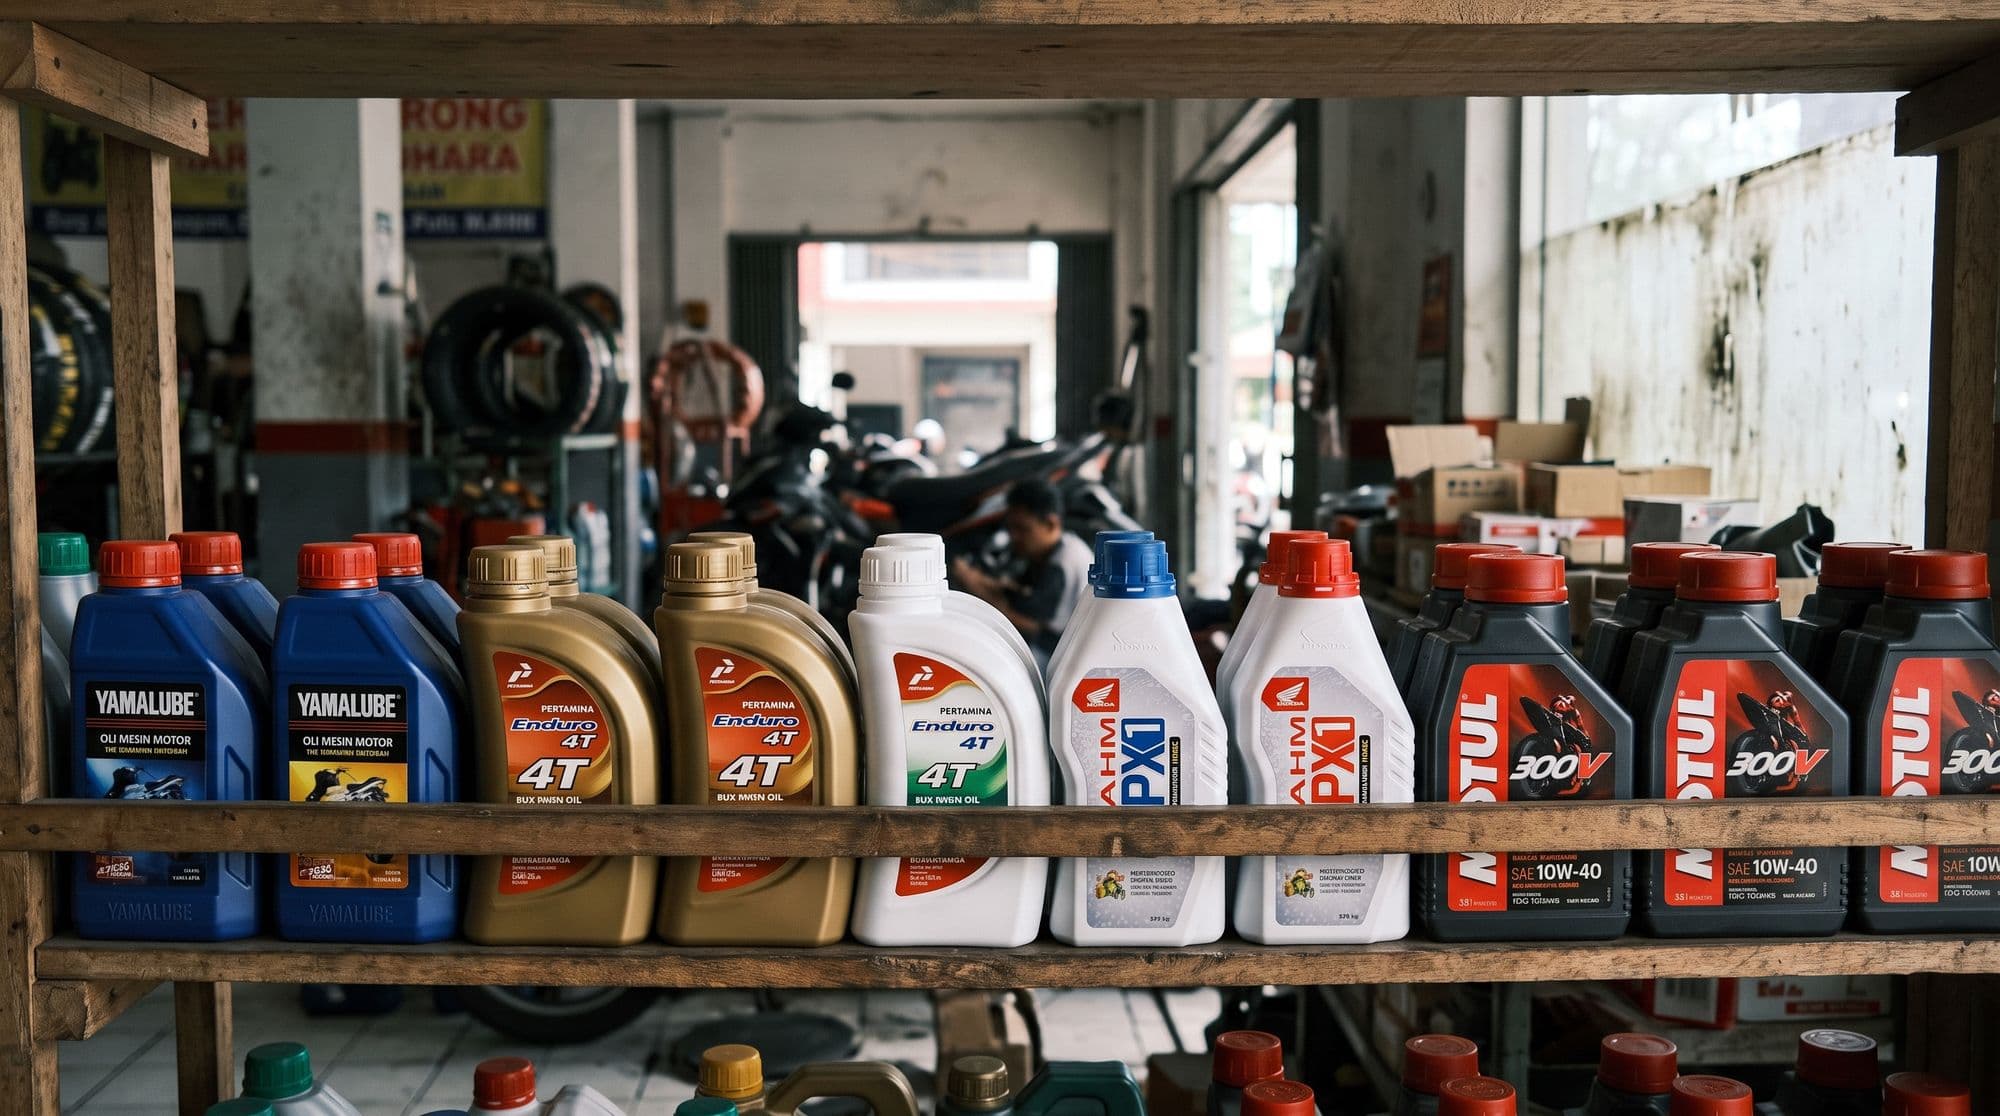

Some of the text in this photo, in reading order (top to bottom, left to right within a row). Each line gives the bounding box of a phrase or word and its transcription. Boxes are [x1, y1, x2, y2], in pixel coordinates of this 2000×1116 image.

[402, 98, 528, 131] RONG
[95, 690, 194, 716] YAMALUBE
[297, 692, 396, 718] YAMALUBE
[541, 705, 594, 713] PERTAMINA
[510, 717, 598, 731] Enduro
[712, 713, 799, 728] Enduro
[912, 721, 994, 732] Enduro
[100, 734, 191, 746] OLI MESIN MOTOR
[303, 736, 393, 748] OLI MESIN MOTOR
[560, 733, 597, 749] 4T
[762, 730, 799, 746] 4T
[959, 737, 993, 749] 4T
[1121, 718, 1166, 805] PX1
[1311, 716, 1356, 804] PX1
[1510, 752, 1612, 780] 300V
[1727, 749, 1830, 776] 300V
[517, 757, 591, 790] 4T
[718, 754, 792, 787] 4T
[916, 762, 977, 789] 4T
[964, 796, 980, 804] OIL
[1512, 863, 1601, 880] SAE 10W-40
[1728, 858, 1817, 875] SAE 10W-40
[1943, 860, 1965, 873] SAE
